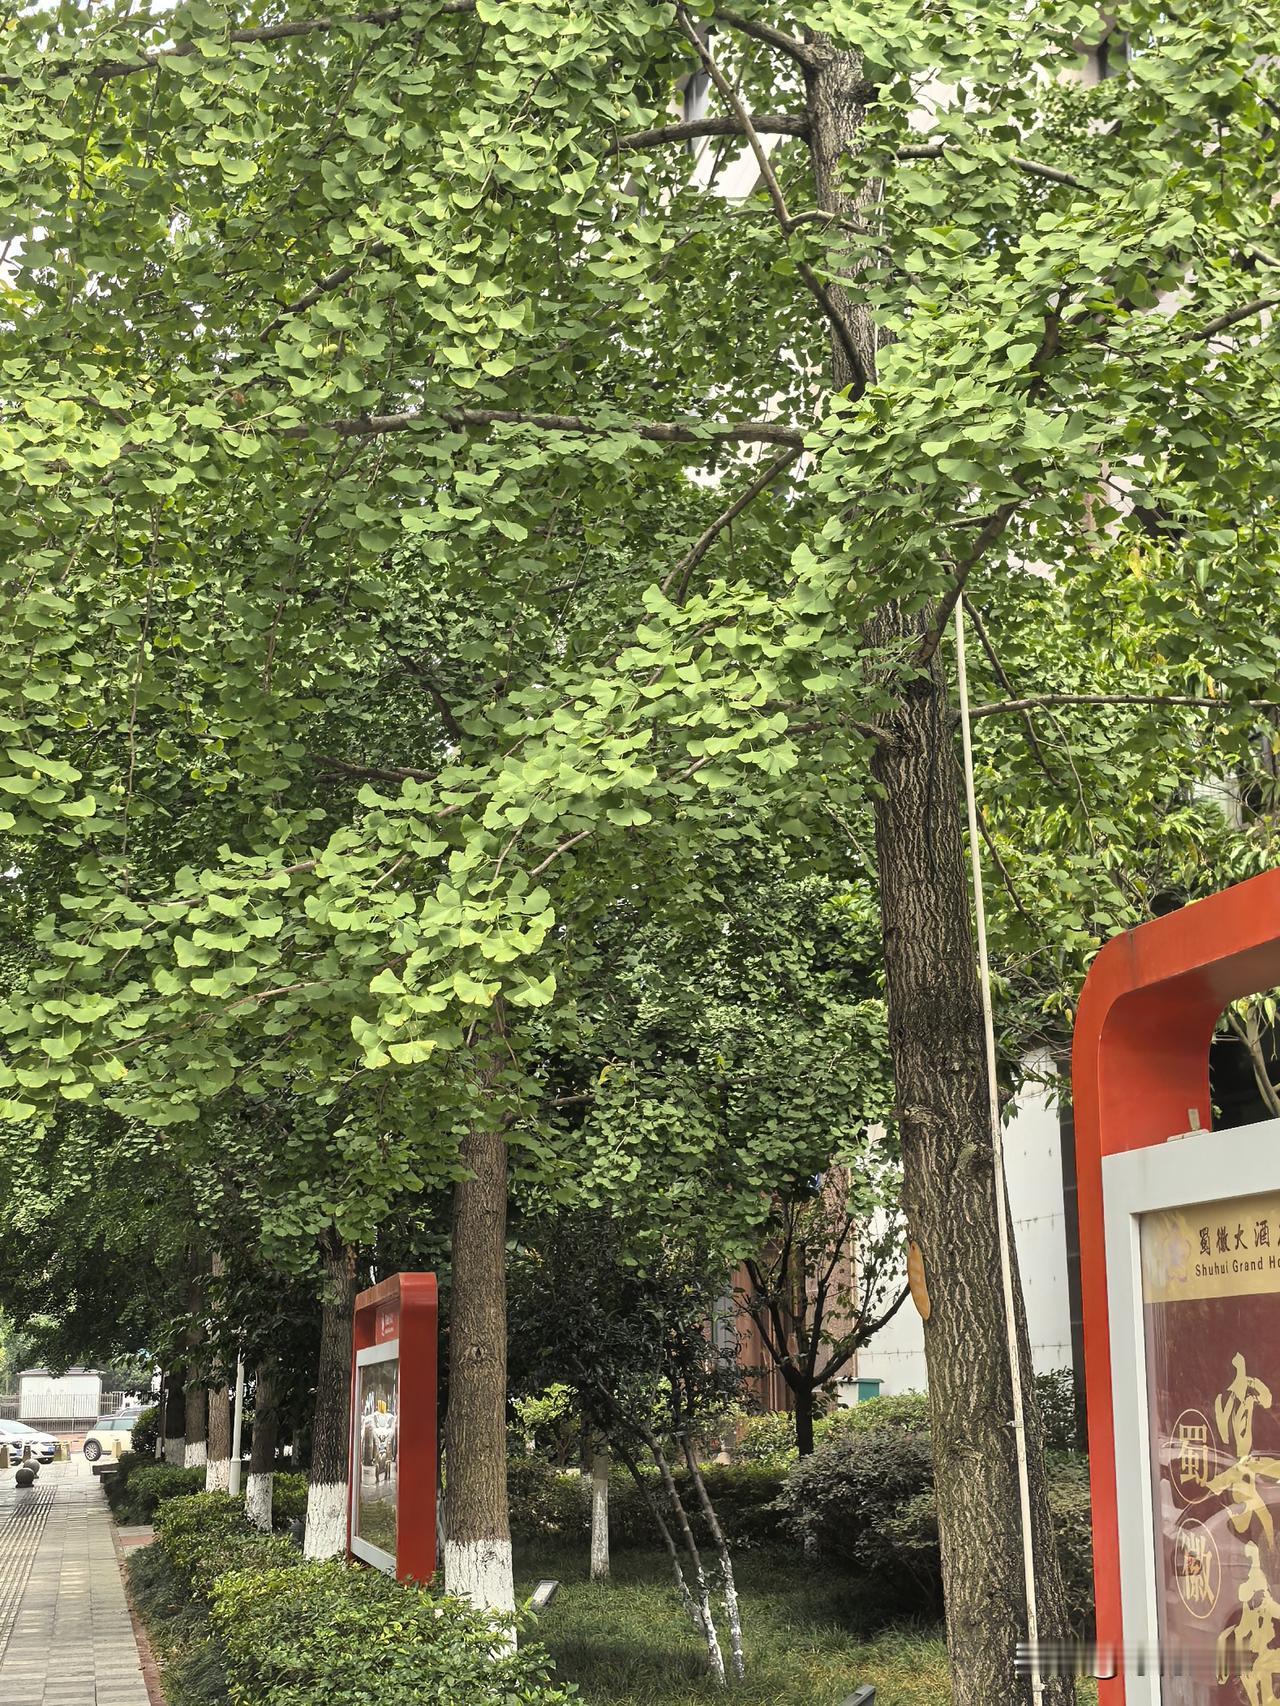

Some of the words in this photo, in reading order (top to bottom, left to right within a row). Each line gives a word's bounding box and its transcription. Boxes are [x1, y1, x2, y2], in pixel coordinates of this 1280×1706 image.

[1199, 1219, 1280, 1256] 蜀徽大酒
[1195, 1261, 1229, 1277] Shuhui
[1232, 1256, 1264, 1273] Grand
